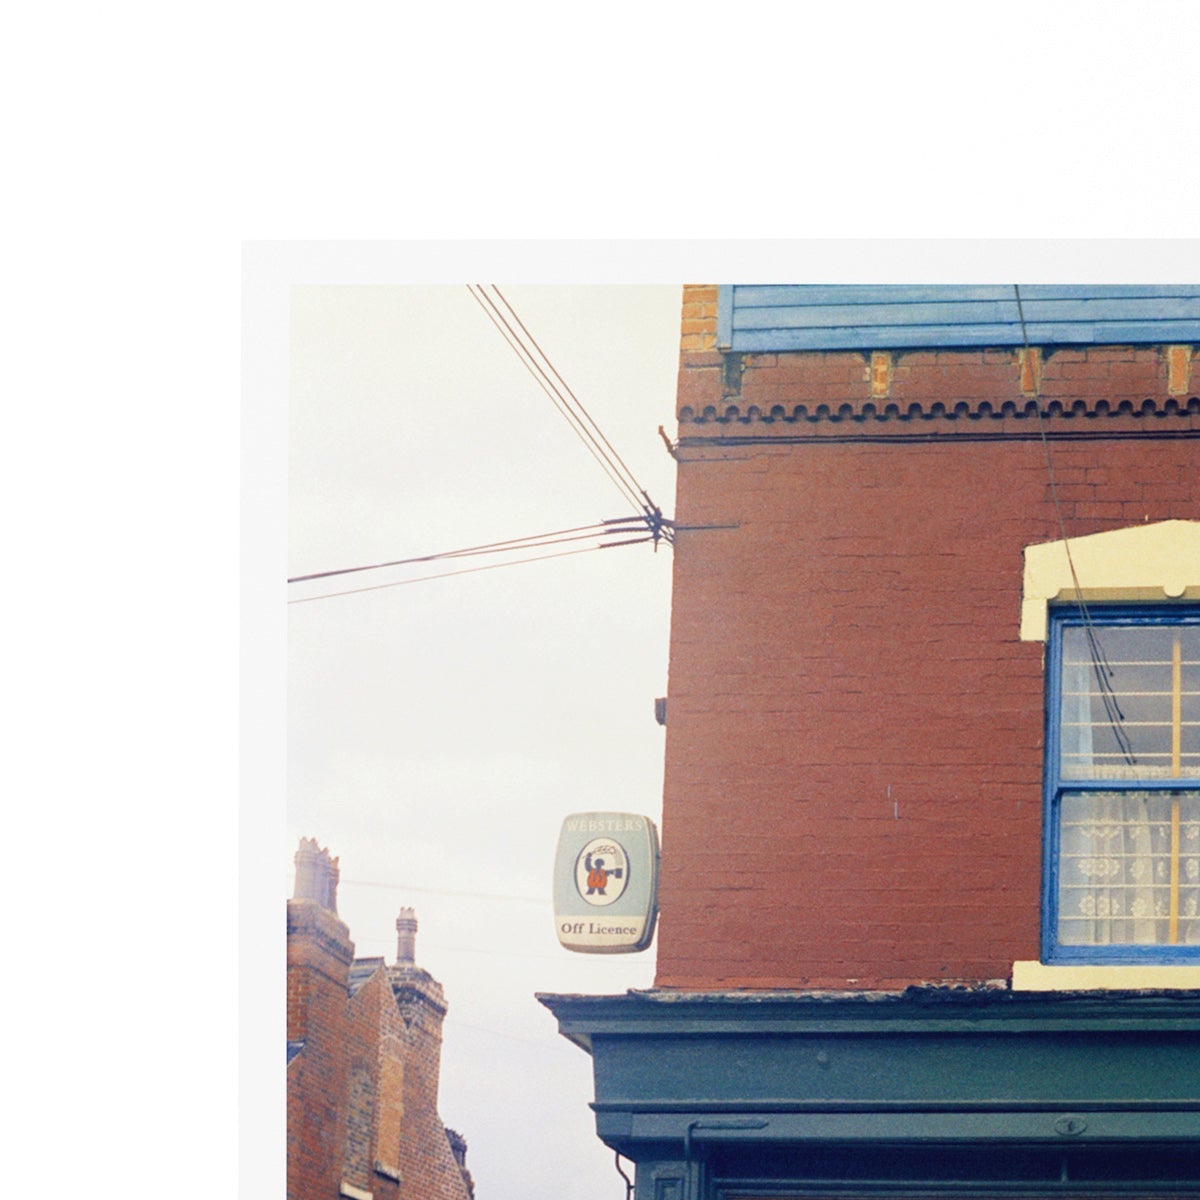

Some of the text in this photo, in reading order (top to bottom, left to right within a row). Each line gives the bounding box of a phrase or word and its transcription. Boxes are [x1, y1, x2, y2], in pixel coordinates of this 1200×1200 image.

[566, 819, 642, 832] WEBSTERS
[561, 922, 637, 935] Off Licence
